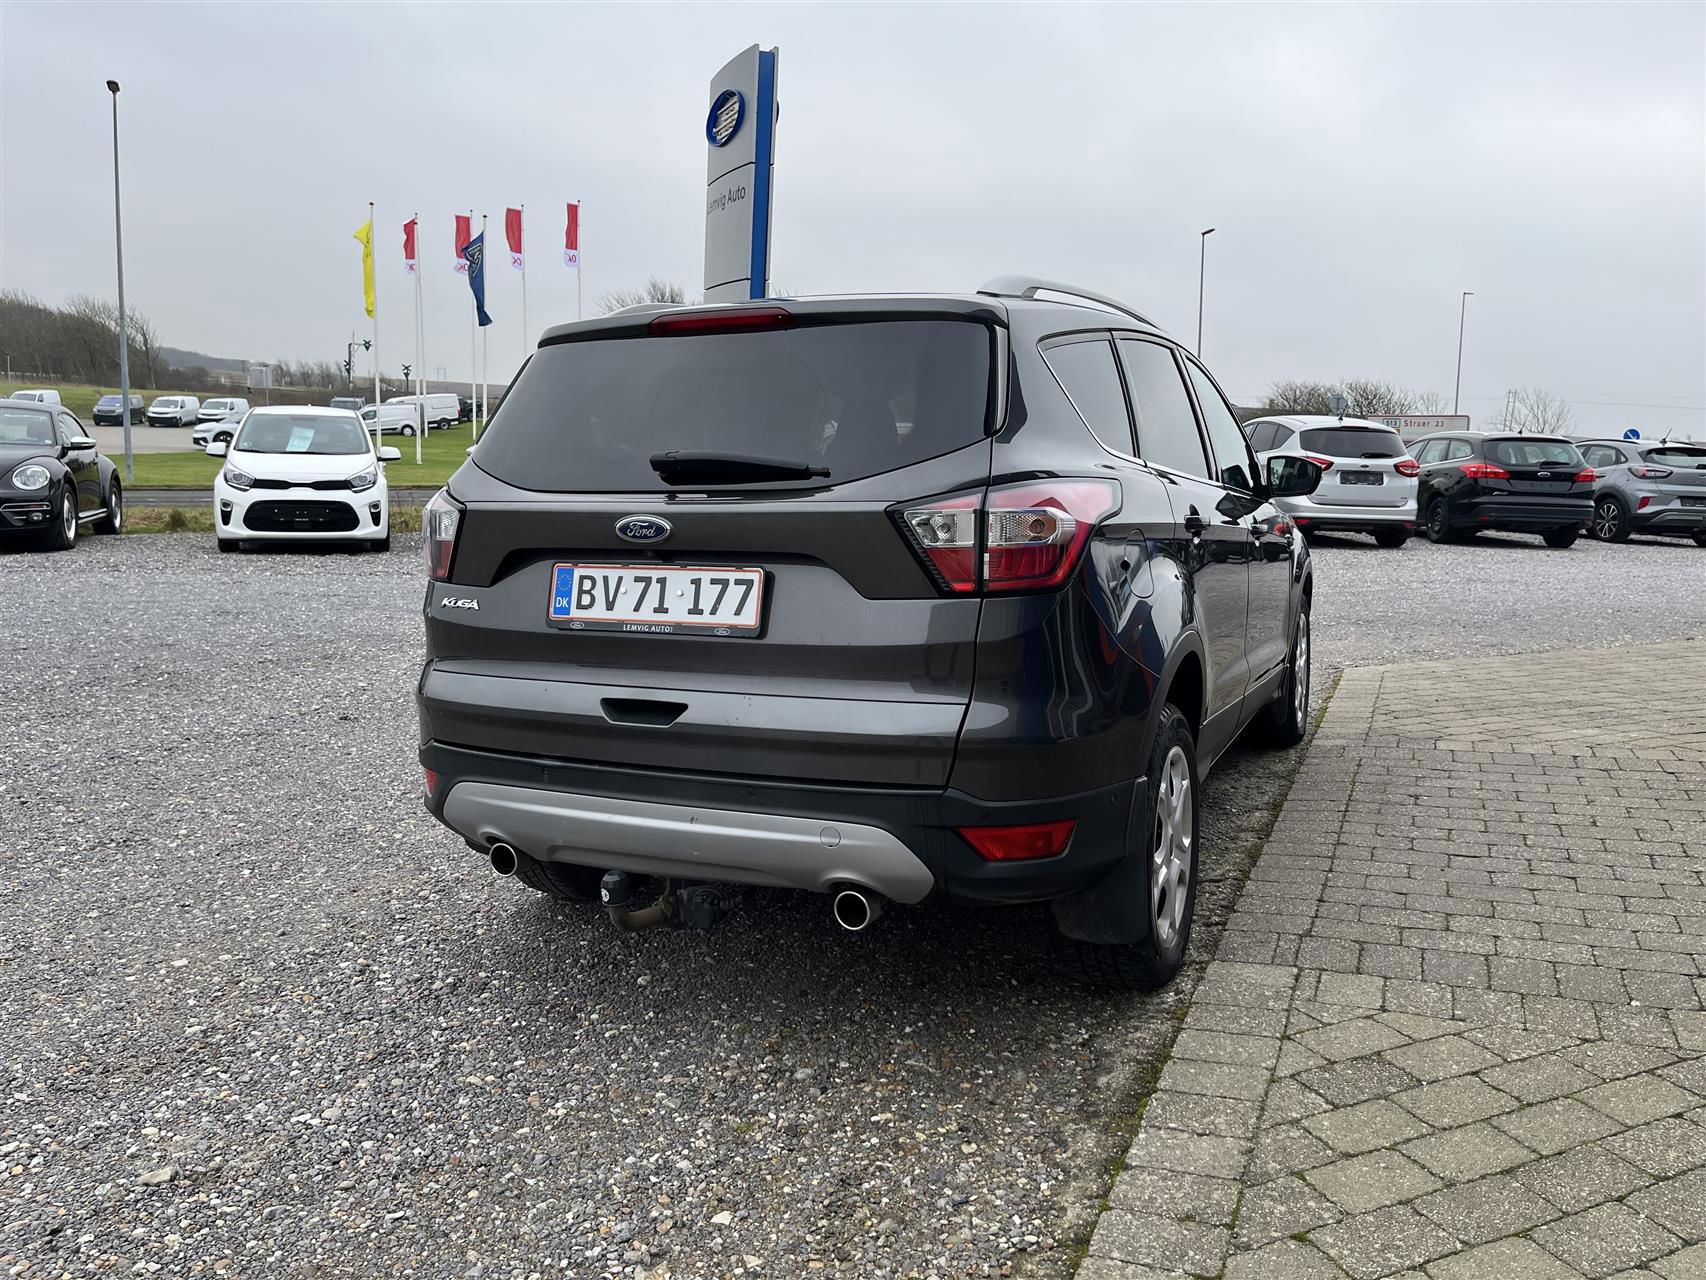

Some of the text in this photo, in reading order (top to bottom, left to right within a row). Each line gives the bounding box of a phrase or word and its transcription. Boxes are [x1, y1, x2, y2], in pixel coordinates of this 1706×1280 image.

[727, 186, 746, 205] Auto
[1403, 419, 1430, 428] Struer
[1435, 420, 1444, 428] 23
[627, 521, 657, 537] Ford
[576, 575, 754, 616] BV 71 177
[556, 597, 569, 608] DK
[623, 624, 649, 632] LEMVIG
